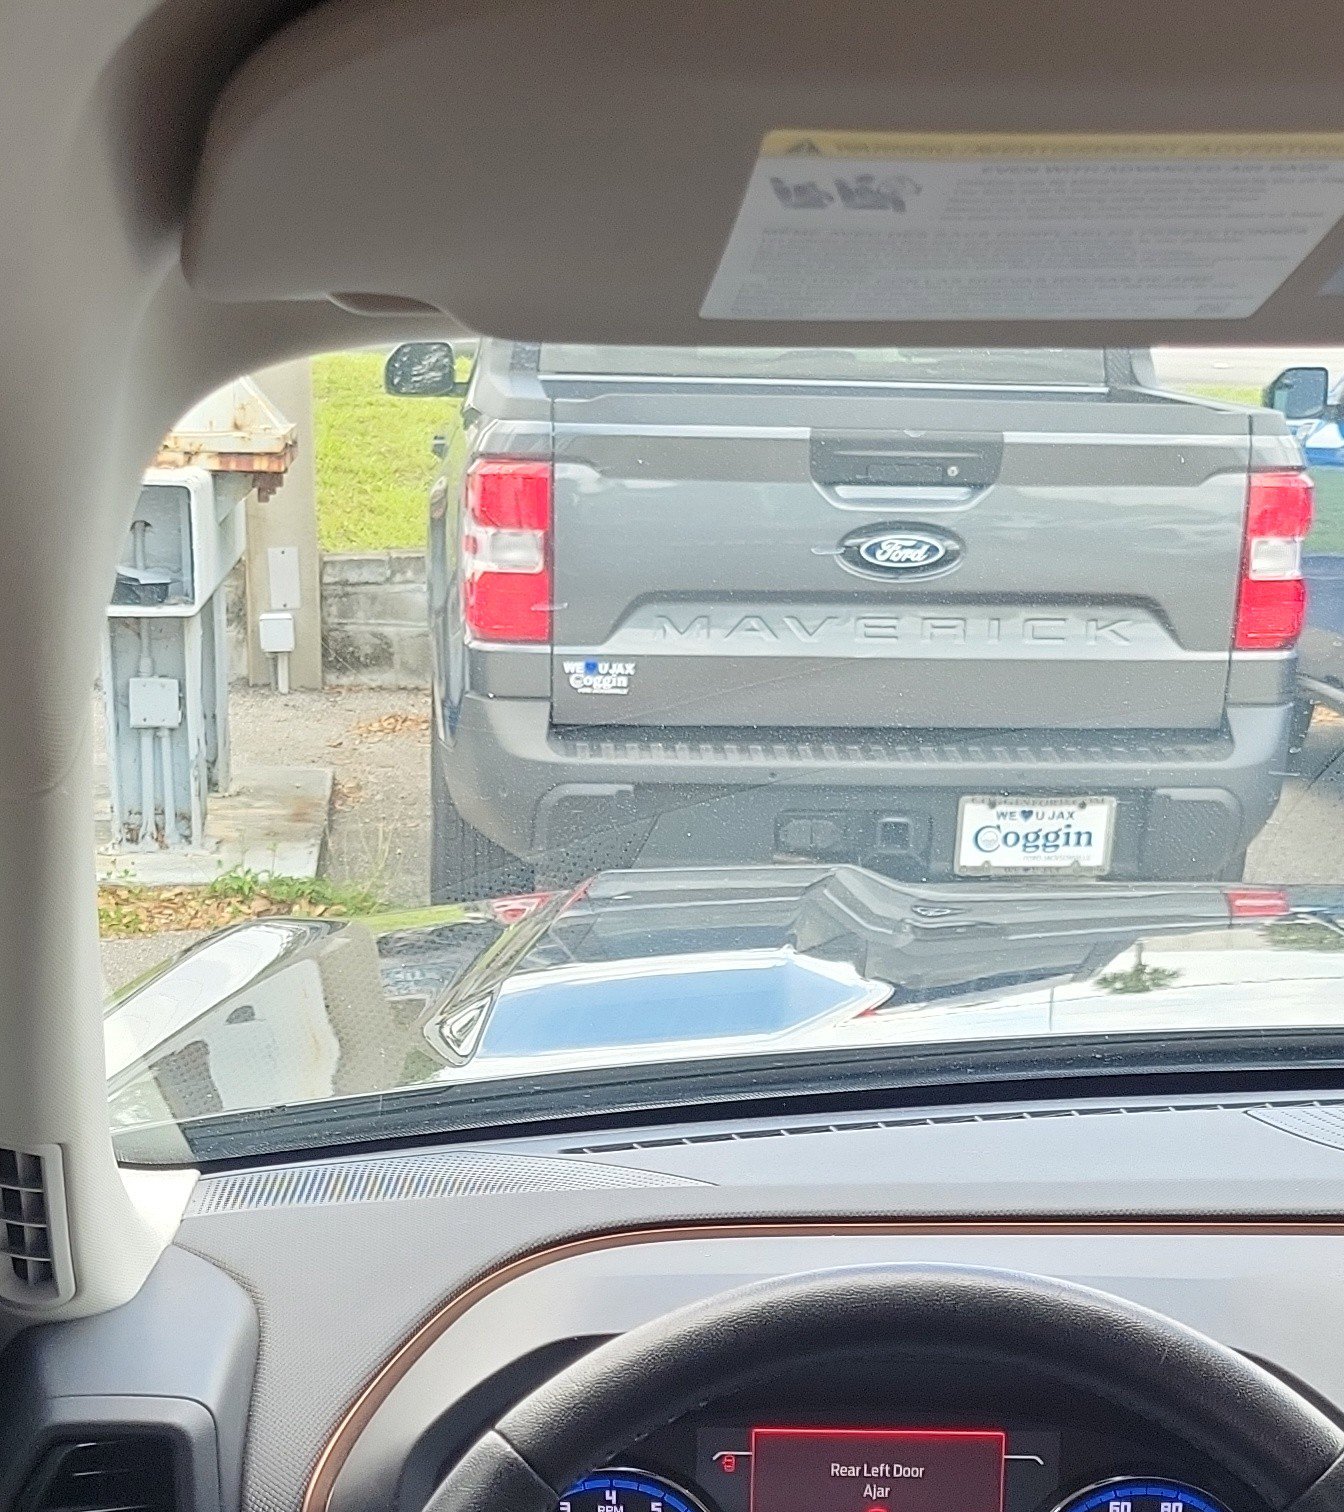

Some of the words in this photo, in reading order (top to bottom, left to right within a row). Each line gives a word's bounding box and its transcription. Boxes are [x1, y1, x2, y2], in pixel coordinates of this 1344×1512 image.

[874, 537, 929, 564] Ford
[656, 615, 1132, 647] MAVERICK
[563, 661, 583, 674] WE
[609, 662, 636, 676] JAX
[996, 810, 1017, 821] WE
[1035, 810, 1045, 820] U
[1047, 810, 1076, 820] JAX
[973, 824, 1093, 853] Coggin
[830, 1463, 861, 1478] Rear
[863, 1463, 890, 1478] Left
[893, 1463, 924, 1478] Door
[605, 1490, 617, 1504] 4
[863, 1484, 890, 1500] Ajar
